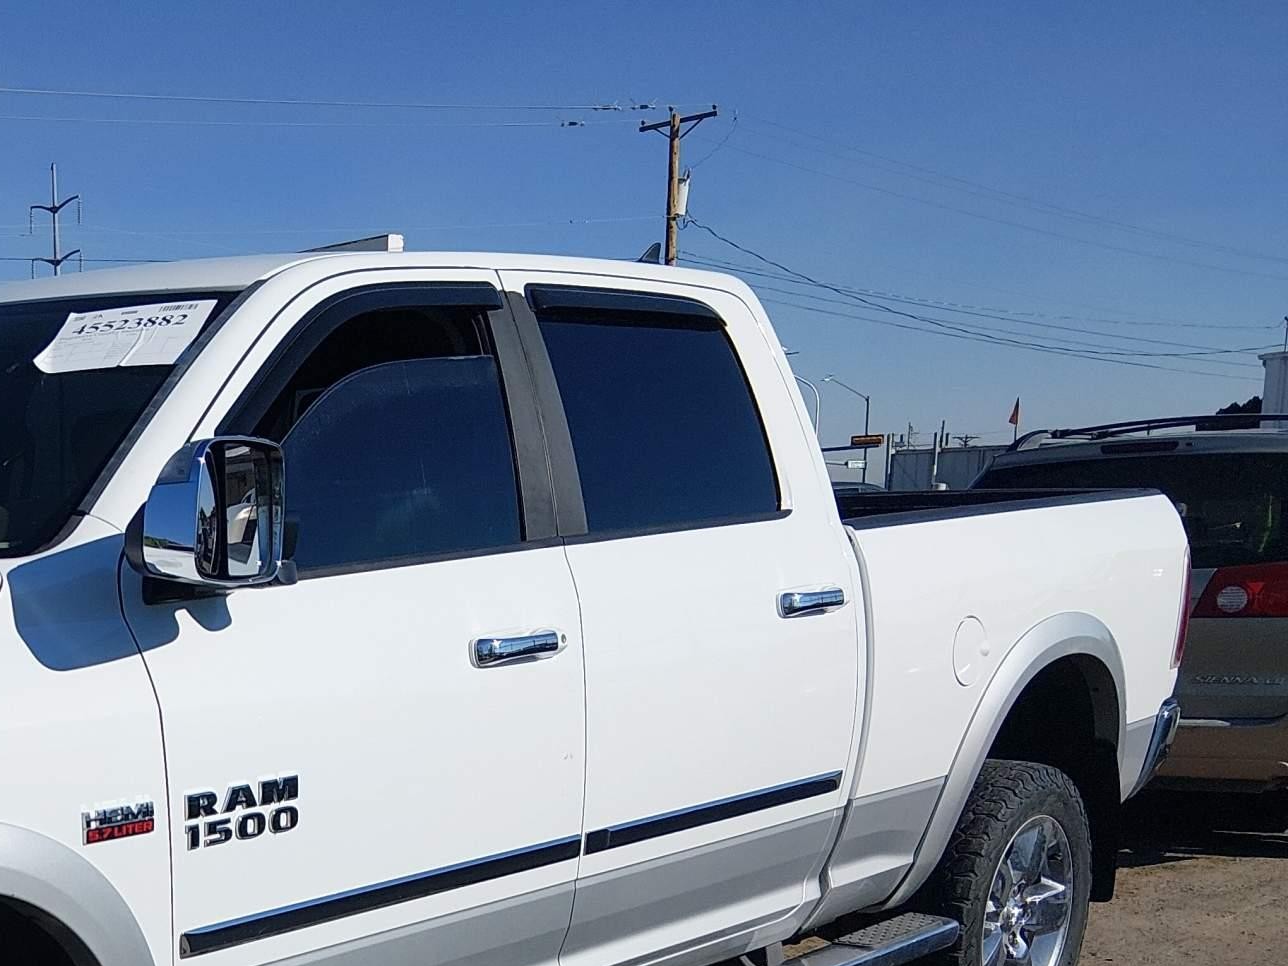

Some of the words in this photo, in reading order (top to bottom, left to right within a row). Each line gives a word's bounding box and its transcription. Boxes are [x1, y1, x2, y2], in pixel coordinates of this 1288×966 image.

[71, 313, 189, 335] 45523882
[184, 774, 299, 821] RAM
[81, 801, 155, 829] HEMI
[114, 820, 153, 838] LITER
[185, 806, 299, 851] 1500
